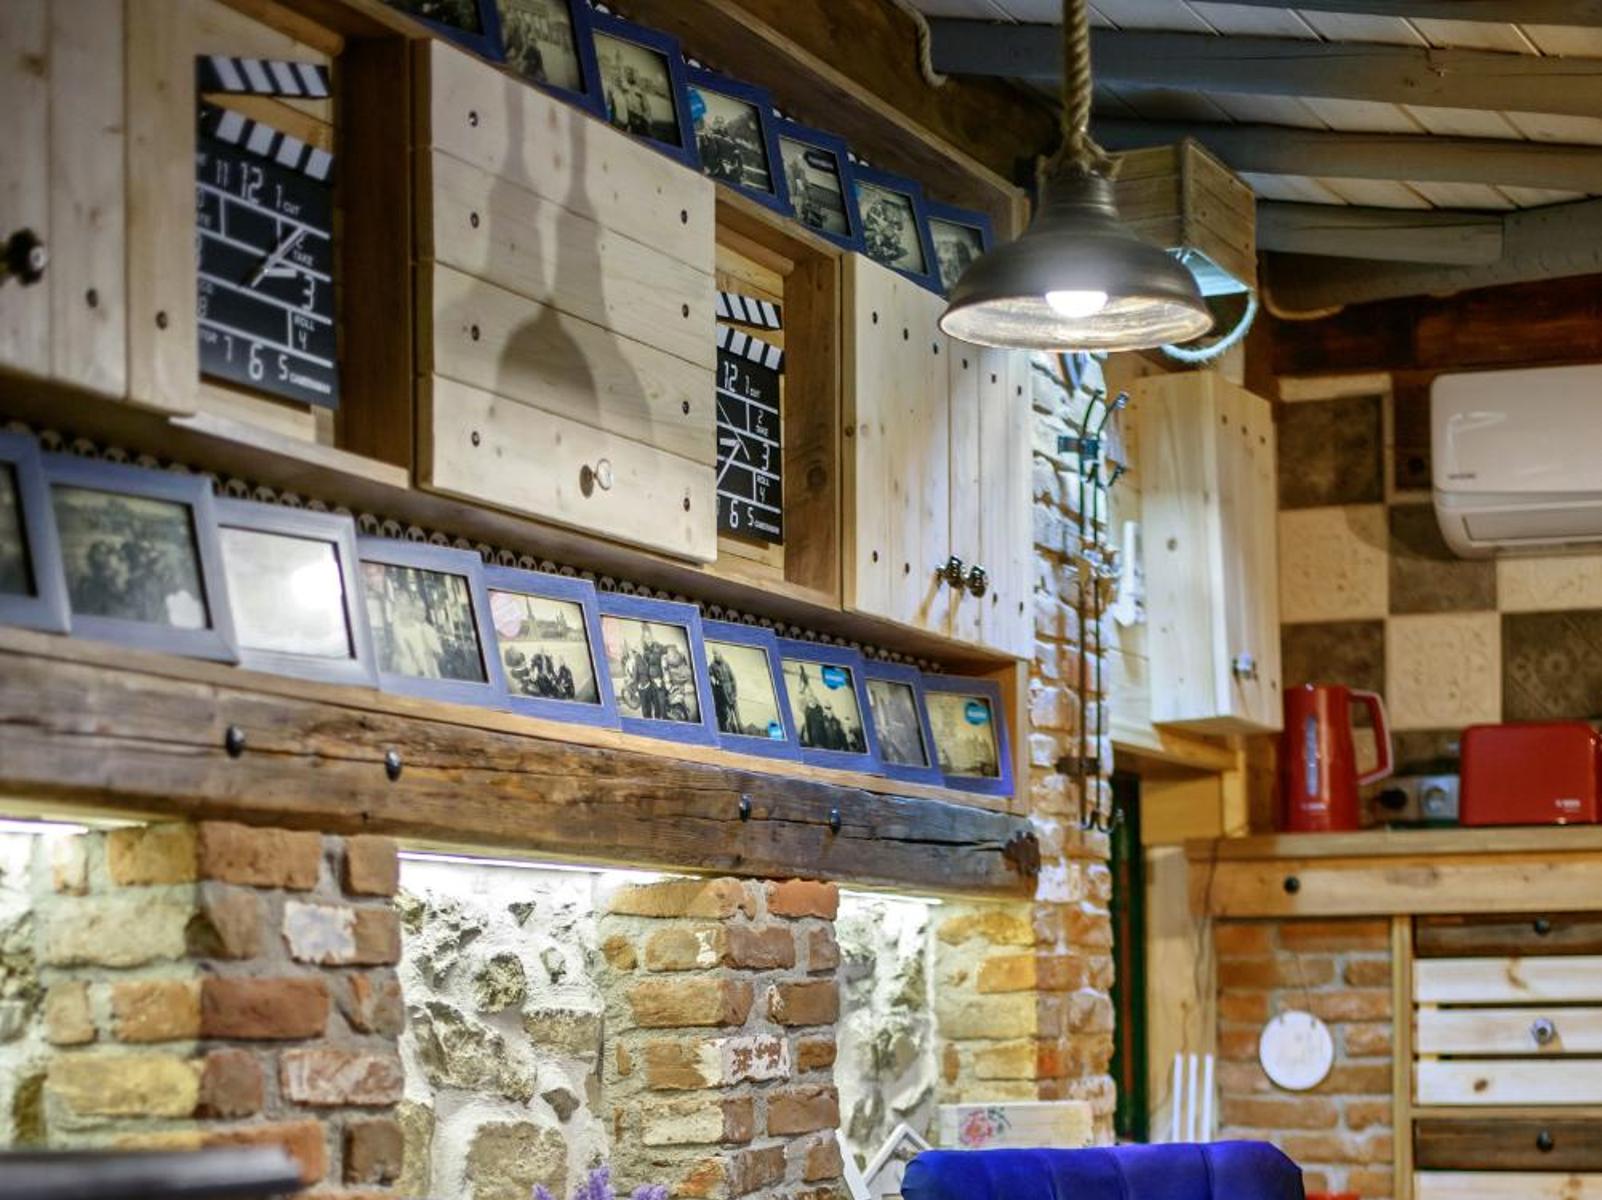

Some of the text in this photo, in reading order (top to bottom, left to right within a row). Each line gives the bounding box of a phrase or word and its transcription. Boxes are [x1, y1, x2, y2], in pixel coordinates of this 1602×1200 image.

[216, 160, 229, 187] 11
[241, 162, 263, 204] 12
[275, 185, 282, 209] 1
[303, 274, 315, 311] 3
[294, 315, 315, 331] ROLL
[224, 336, 232, 361] 7
[298, 330, 308, 350] 4
[249, 342, 263, 381] 6
[278, 353, 289, 380] 5
[724, 361, 738, 393] 12
[758, 410, 764, 425] 2
[762, 442, 770, 472] 3
[760, 487, 766, 502] 4
[729, 500, 739, 528] 6
[747, 506, 755, 527] 5
